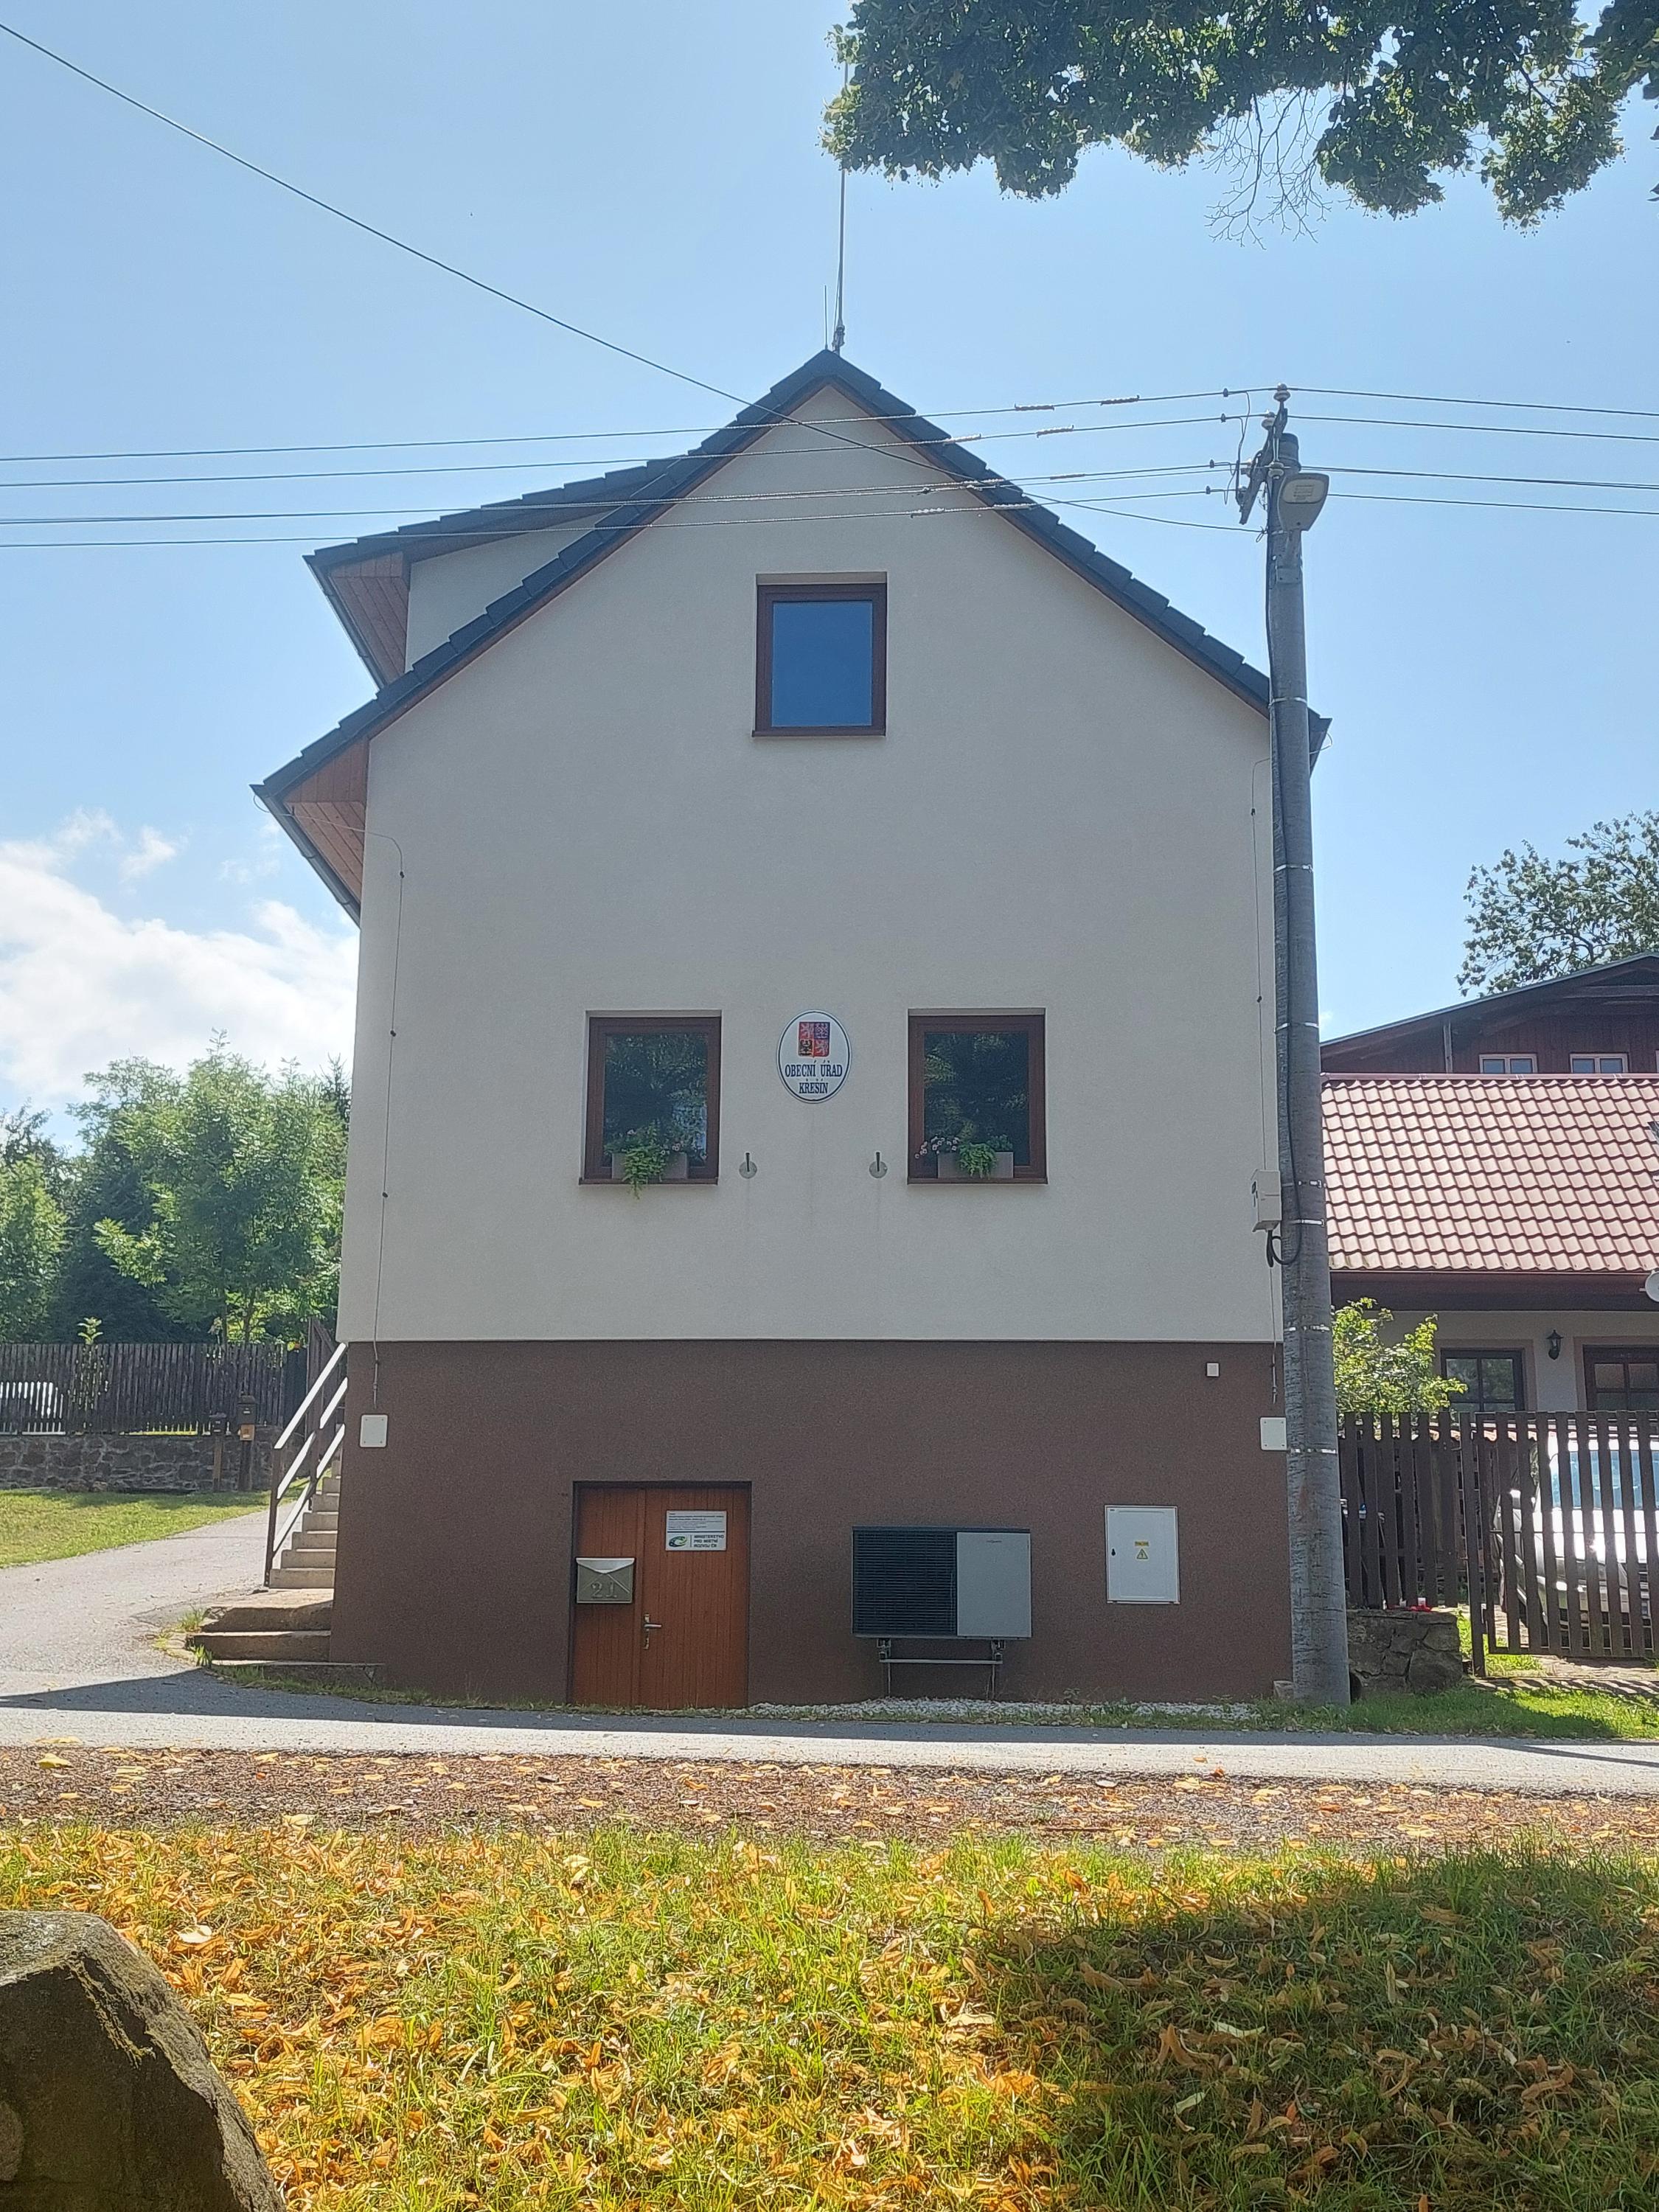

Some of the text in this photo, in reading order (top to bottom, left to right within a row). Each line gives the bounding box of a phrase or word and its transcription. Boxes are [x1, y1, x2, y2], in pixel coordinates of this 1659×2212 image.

[785, 1060, 843, 1077] OBECNÍ ÚŘAD
[799, 1078, 829, 1094] KŘEŠÍN
